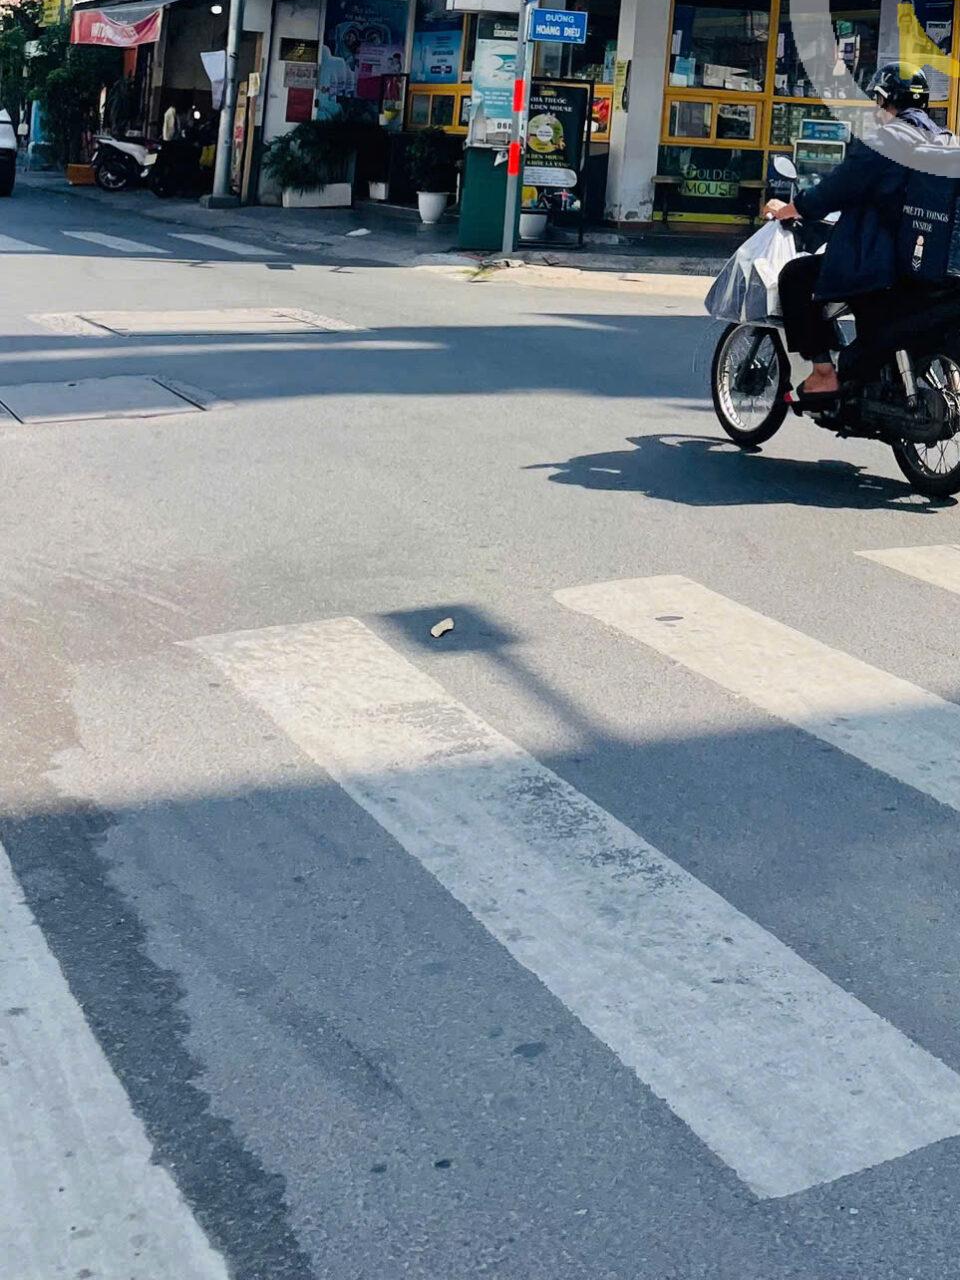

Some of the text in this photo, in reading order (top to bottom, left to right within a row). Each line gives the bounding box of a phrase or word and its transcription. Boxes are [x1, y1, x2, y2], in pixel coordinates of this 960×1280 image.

[545, 12, 575, 24] ĐƯỜNG
[683, 163, 741, 181] GOLDEN
[685, 181, 737, 197] MOUSE
[902, 205, 950, 223] PRETTY THINGS
[912, 220, 934, 233] INSIDE
